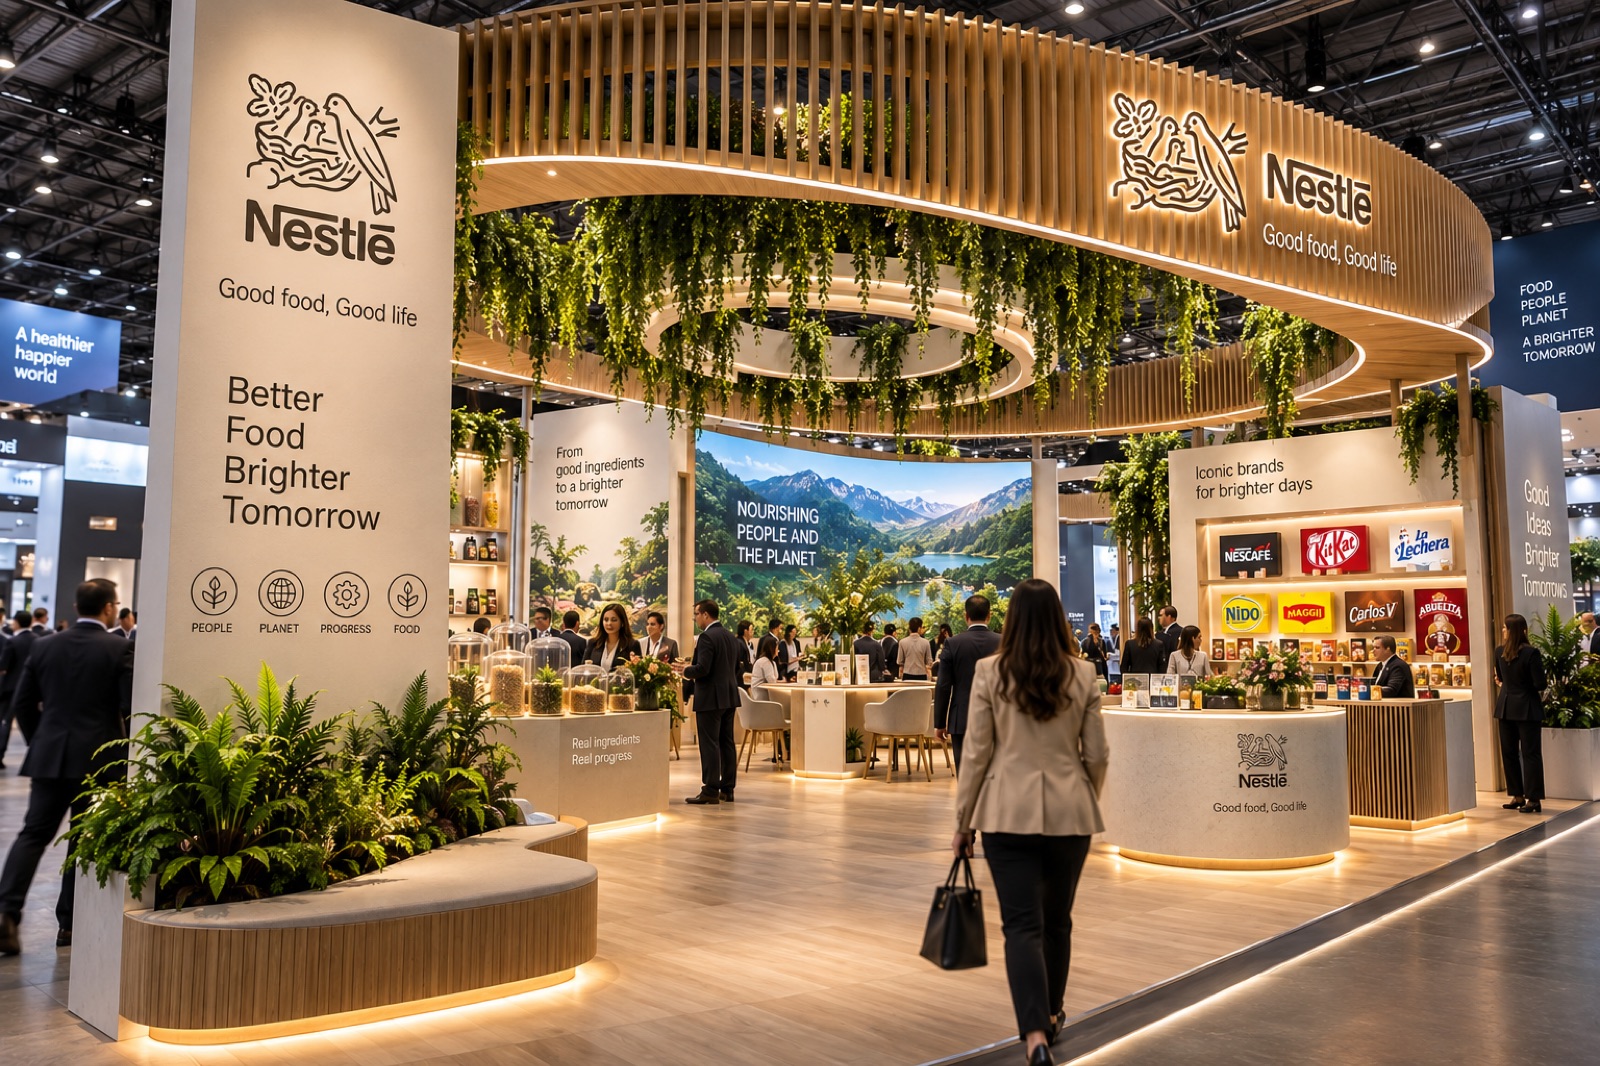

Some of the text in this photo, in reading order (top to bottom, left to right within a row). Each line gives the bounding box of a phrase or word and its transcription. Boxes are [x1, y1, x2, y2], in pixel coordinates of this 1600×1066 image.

[1263, 223, 1397, 277] Good food, Good life
[1520, 280, 1553, 296] FOOD
[219, 278, 418, 327] Good food, Good life
[1521, 292, 1566, 311] PEOPLE
[1522, 308, 1568, 327] PLANET
[15, 326, 94, 353] A healthier
[1522, 326, 1594, 348] A BRIGHTER
[15, 344, 73, 367] happier
[1523, 341, 1596, 363] TOMORROW
[14, 366, 57, 384] world
[228, 375, 324, 412] Better
[226, 415, 304, 450] Food
[556, 446, 583, 459] From
[225, 455, 350, 494] Brighter
[556, 457, 645, 479] good ingredients
[1195, 458, 1284, 480] Iconic brands
[556, 478, 624, 493] to a brighter
[1195, 478, 1313, 500] for brighter days
[1524, 479, 1550, 507] Good
[223, 495, 380, 530] Tomorrow
[556, 499, 608, 511] tomorrow
[737, 500, 819, 524] NOURISHING
[737, 523, 819, 545] PEOPLE AND
[1415, 529, 1428, 541] La
[1526, 511, 1552, 537] Ideas
[736, 546, 817, 566] THE PLANET
[1395, 538, 1450, 562] Lechera
[1525, 542, 1560, 572] Brighter
[1521, 574, 1568, 599] Tomorrows
[1349, 601, 1398, 623] Carlos V
[1419, 602, 1463, 619] ABUELITA
[191, 623, 233, 633] PEOPLE
[259, 623, 300, 633] PLANET
[320, 624, 372, 634] PROGRESS
[394, 625, 421, 634] FOOD
[572, 734, 641, 750] Real ingredients
[572, 752, 633, 766] Real progress
[1213, 802, 1242, 813] Good
[1244, 802, 1269, 814] food,
[1270, 801, 1295, 812] Good
